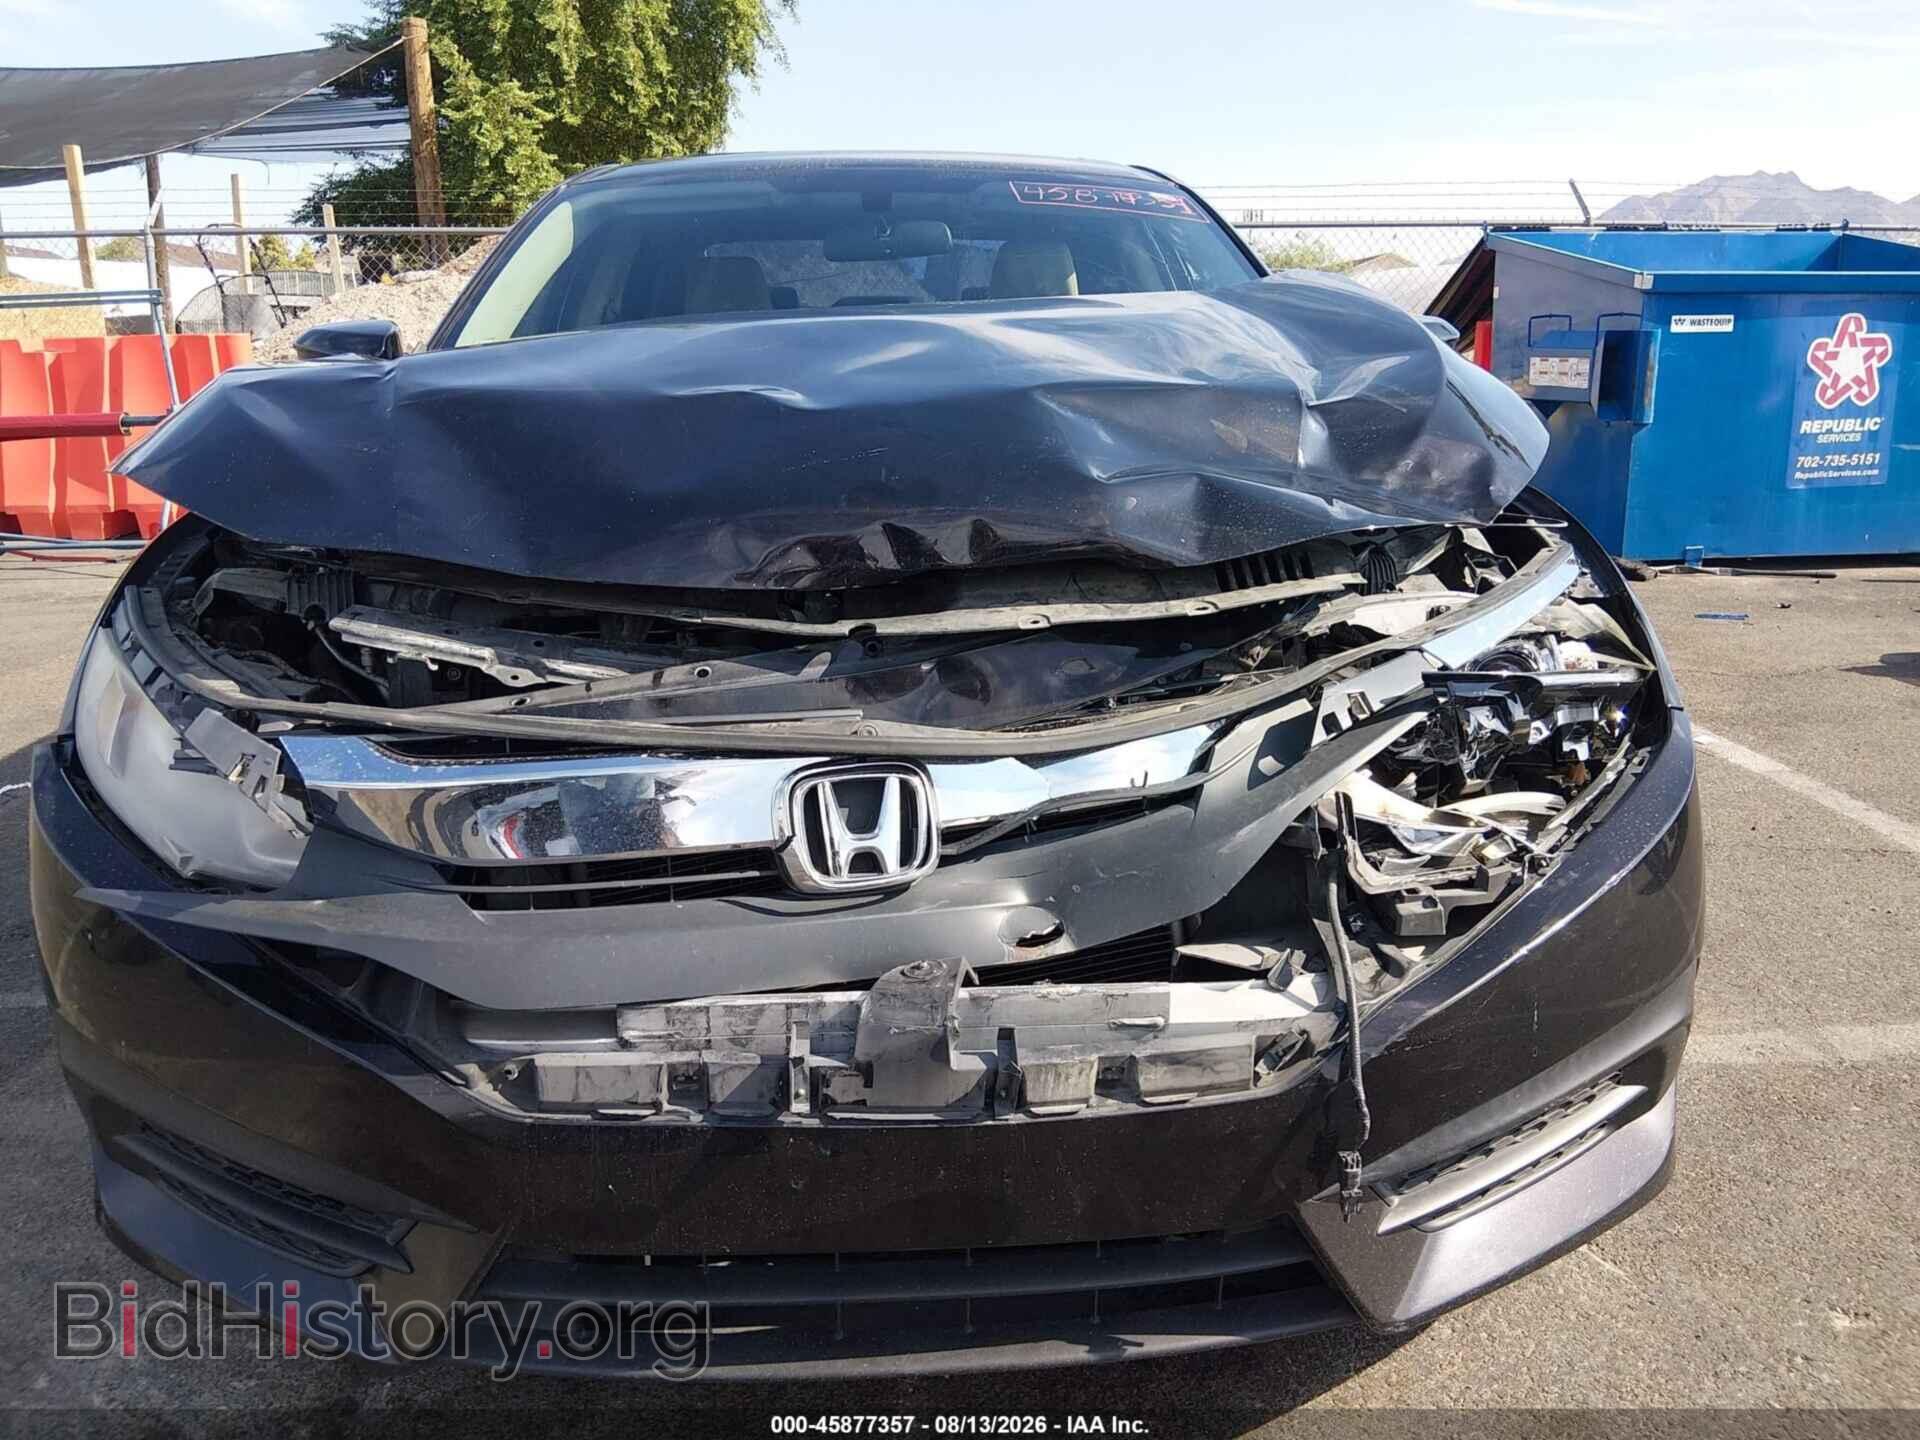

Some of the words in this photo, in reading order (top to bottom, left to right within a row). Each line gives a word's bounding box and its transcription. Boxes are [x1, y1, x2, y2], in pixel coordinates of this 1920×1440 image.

[1800, 416, 1882, 434] REPUBLIC
[1816, 432, 1862, 444] SERVICES
[1796, 452, 1881, 468] 702-735-5151
